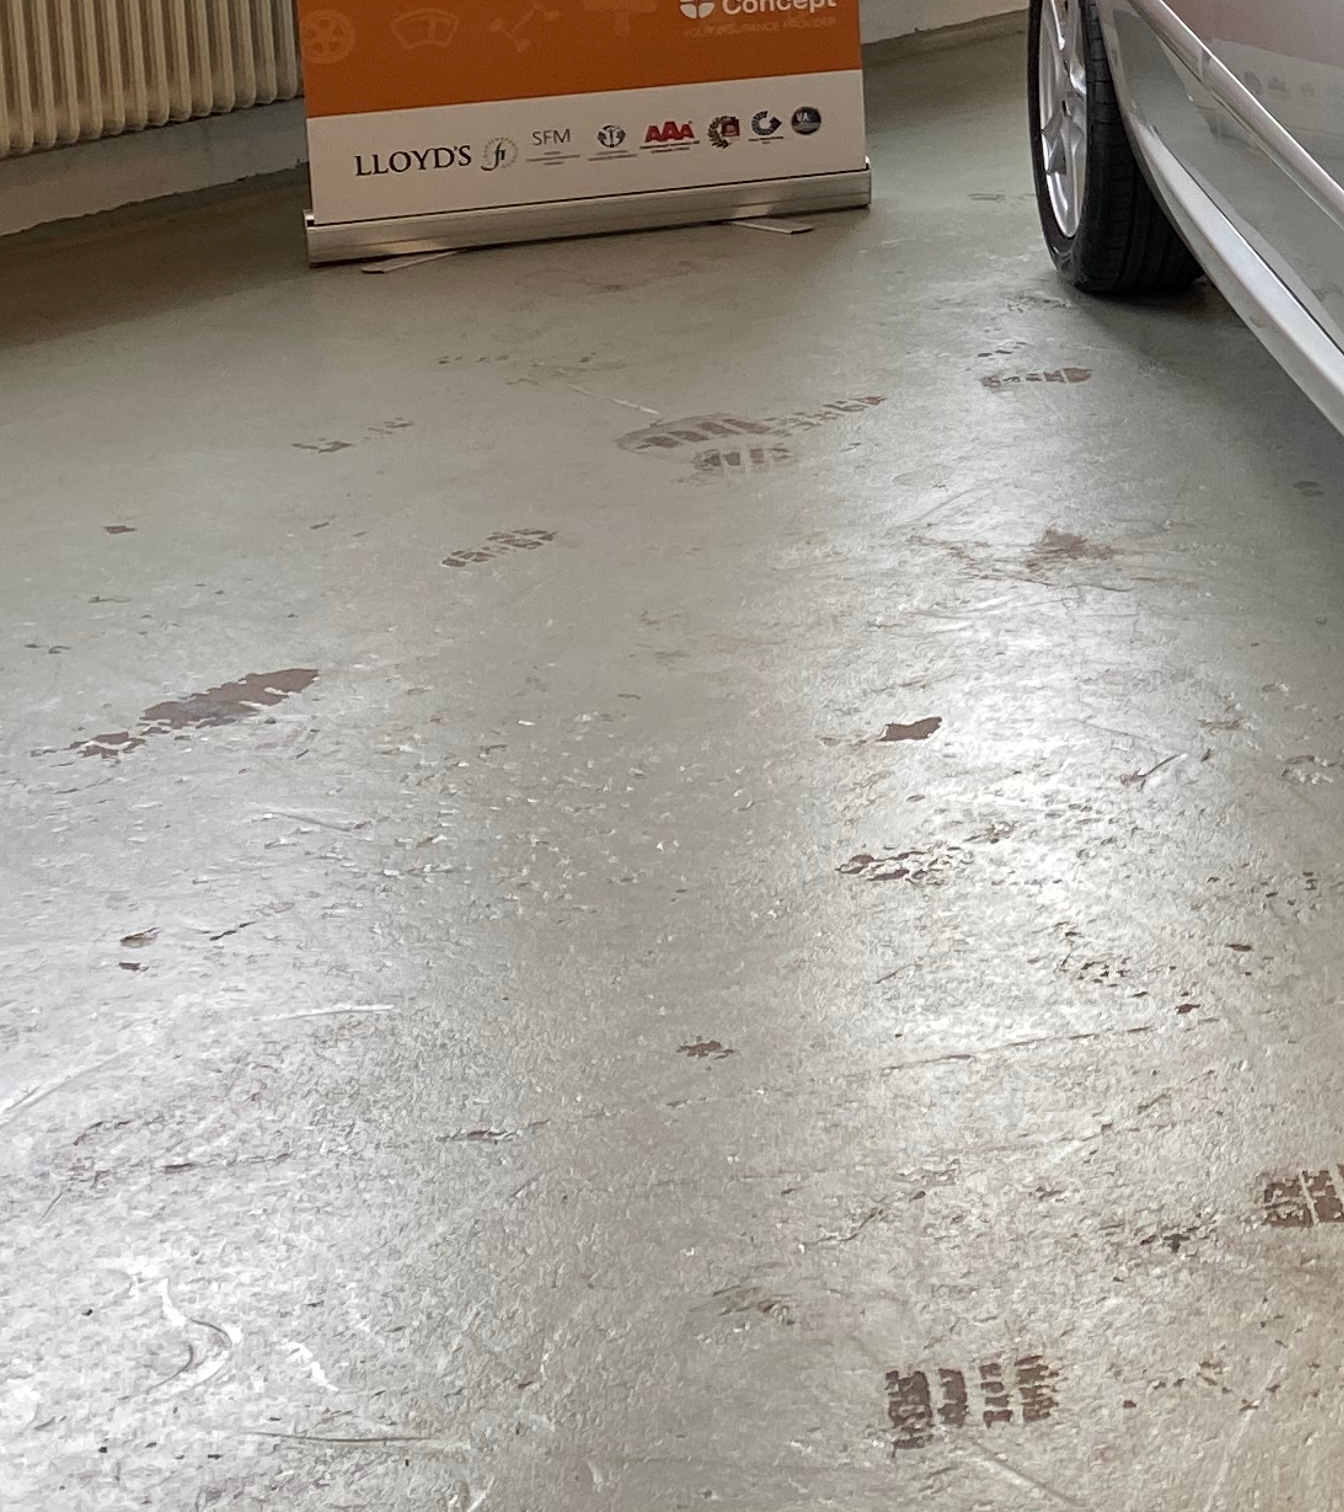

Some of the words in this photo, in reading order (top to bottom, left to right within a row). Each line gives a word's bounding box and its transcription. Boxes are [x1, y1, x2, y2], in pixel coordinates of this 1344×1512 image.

[353, 144, 472, 177] LLOYD'S
[531, 128, 571, 146] SFM
[645, 120, 695, 144] AAA
